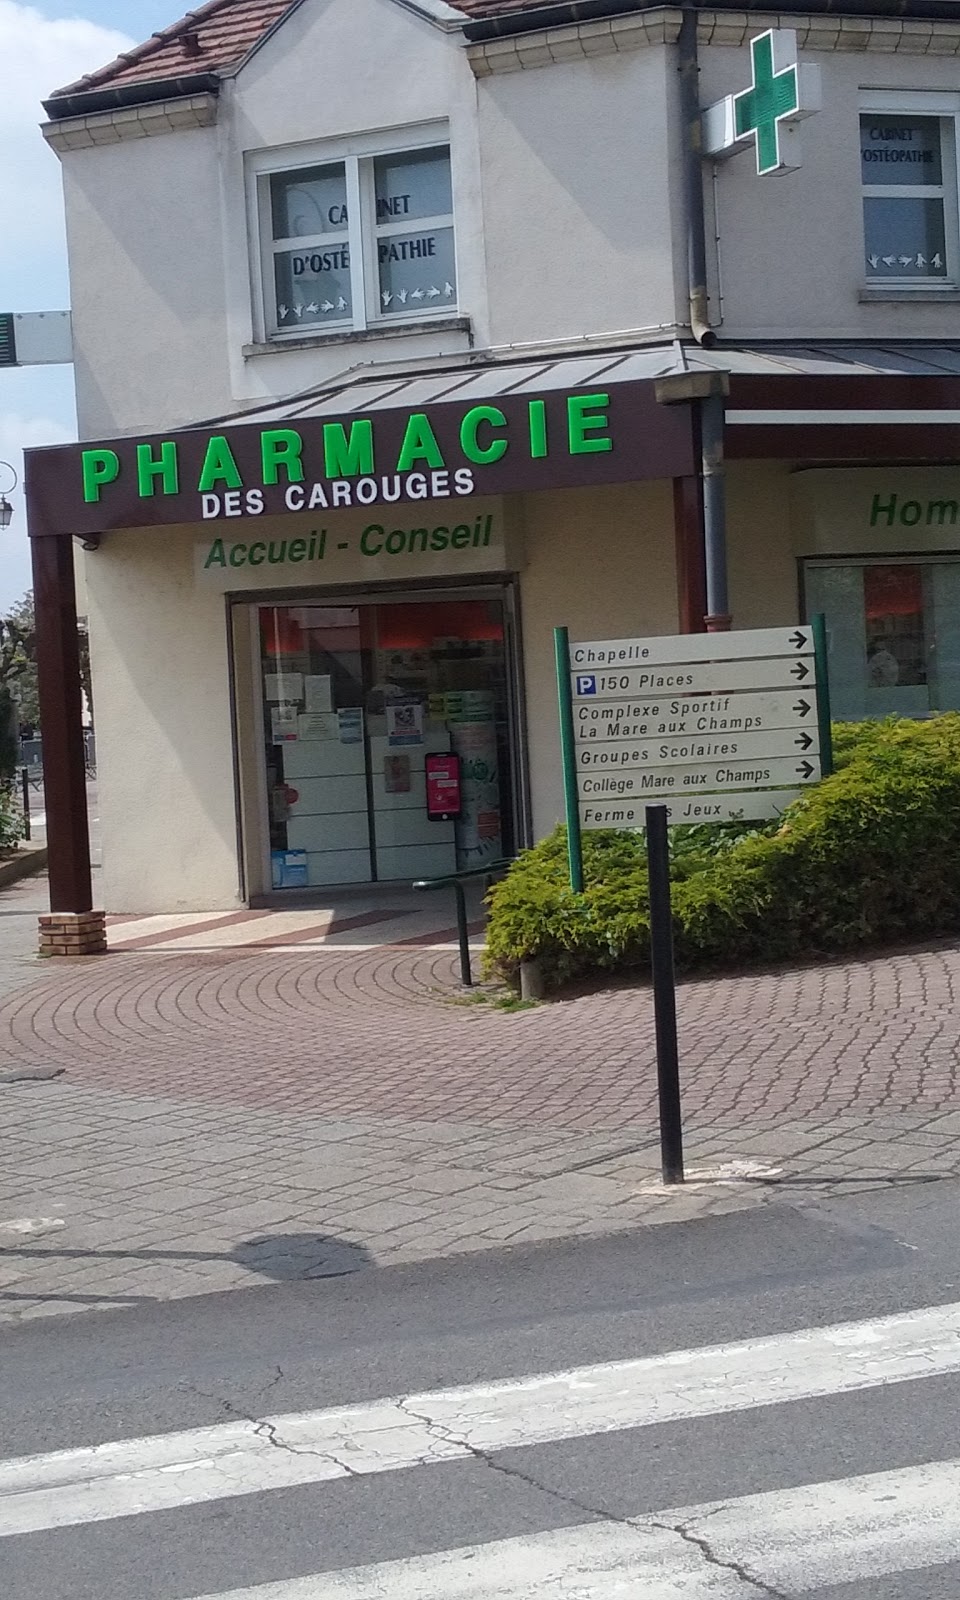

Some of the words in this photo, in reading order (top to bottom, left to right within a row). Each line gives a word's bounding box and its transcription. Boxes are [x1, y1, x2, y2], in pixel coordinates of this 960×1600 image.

[293, 237, 436, 275] D'OSTÉPATHIE
[81, 393, 613, 503] PHARMACIE
[202, 489, 264, 519] DES
[284, 468, 475, 511] CAROUGES
[203, 529, 328, 569] Accueil
[359, 514, 494, 556] Conseil
[574, 645, 650, 663] Chapelle
[600, 676, 630, 691] 150
[638, 674, 693, 688] Places
[578, 703, 660, 721] Complexe
[669, 698, 730, 717] Sportif
[579, 725, 597, 738] La
[606, 722, 648, 736] Mare
[657, 721, 686, 733] aux
[696, 715, 762, 731] Champs
[580, 748, 649, 765] Groupes
[659, 741, 738, 759] Scolaires
[582, 777, 634, 793] Collège
[641, 774, 675, 788] Mare
[682, 773, 707, 786] aux
[715, 767, 771, 783] Champs
[584, 808, 636, 823] Ferme
[682, 803, 722, 817] Jeux
